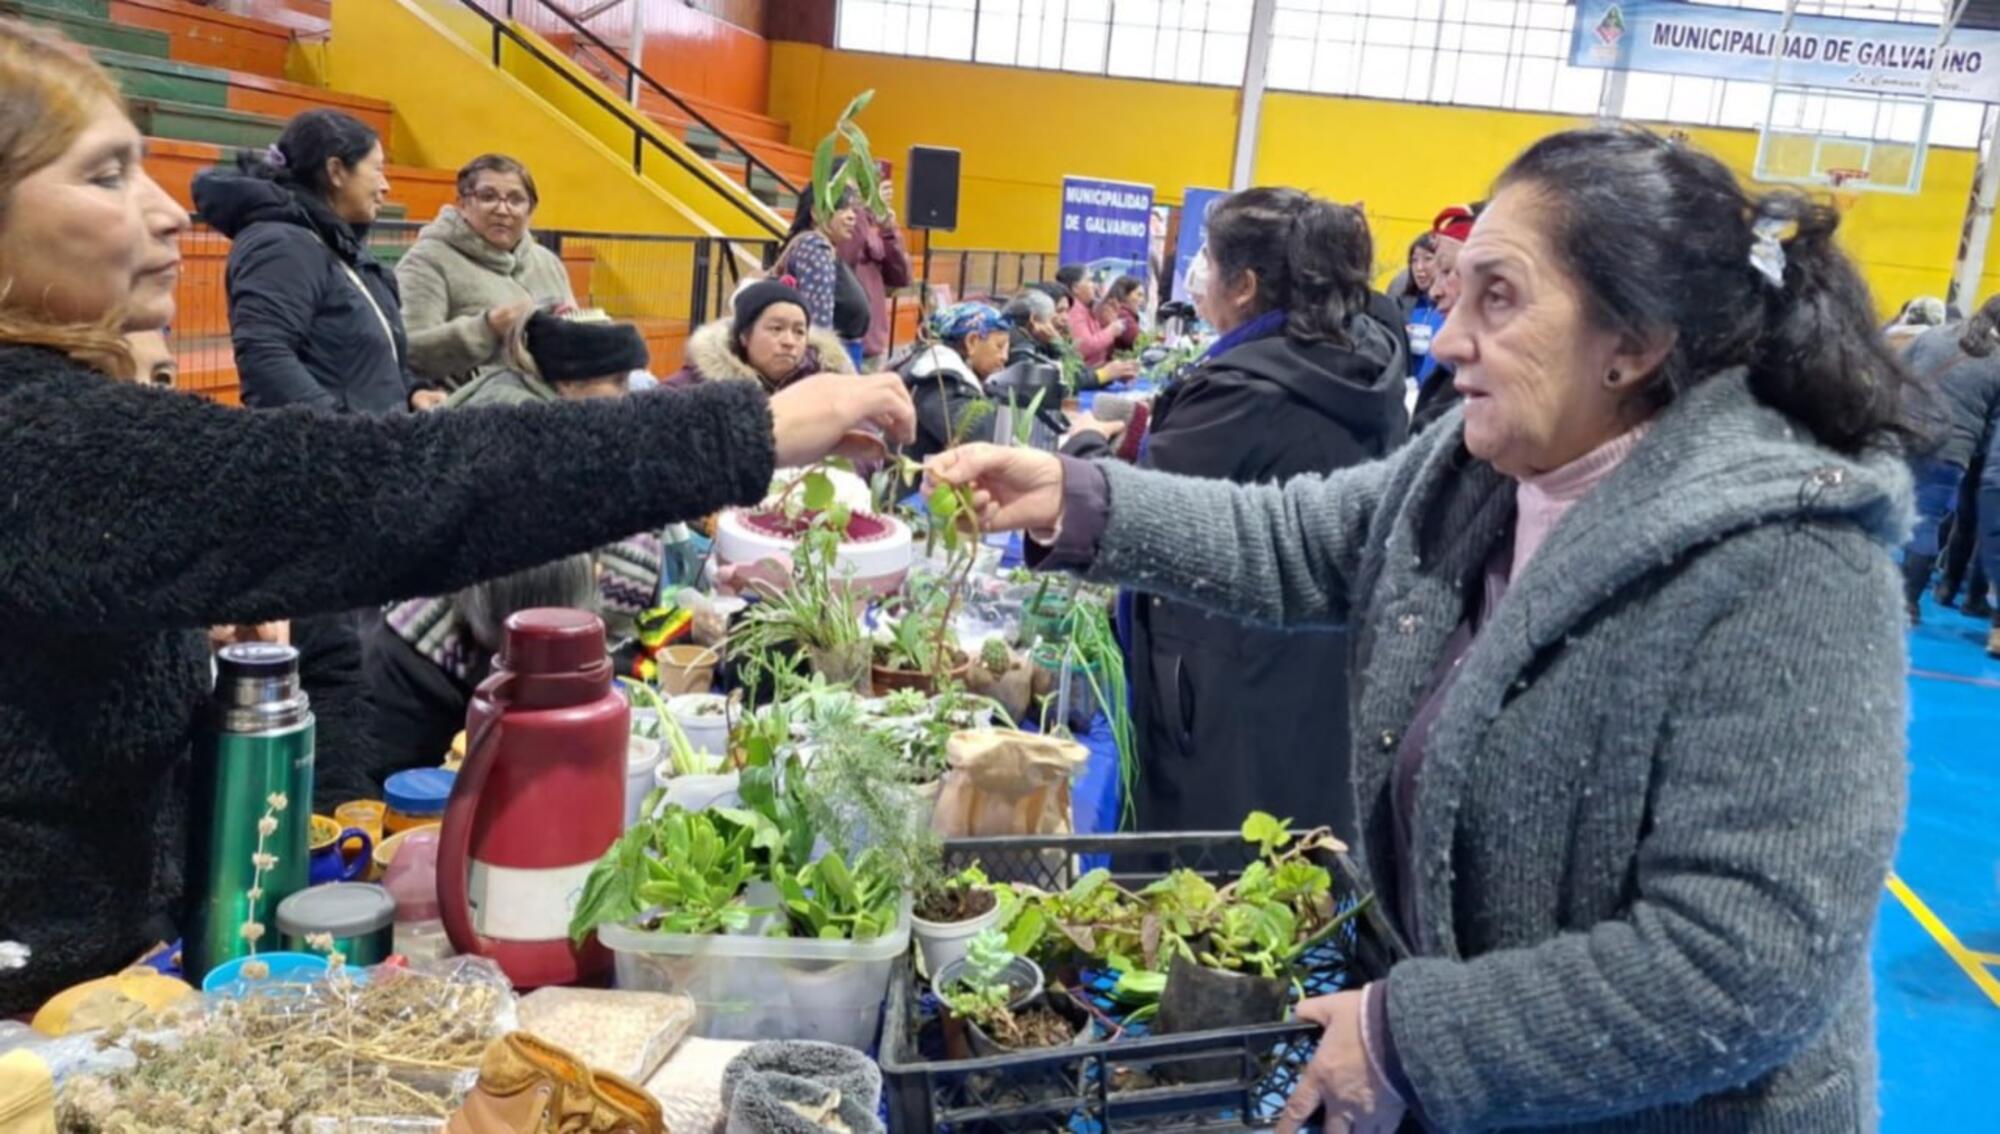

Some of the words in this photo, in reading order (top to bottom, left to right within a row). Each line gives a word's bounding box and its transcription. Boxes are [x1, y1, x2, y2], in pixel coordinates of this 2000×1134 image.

[1823, 39, 1852, 63] DE
[1066, 187, 1149, 211] MUNICIPALIDAD
[1065, 214, 1080, 231] DE
[1085, 216, 1146, 238] GALVARINO
